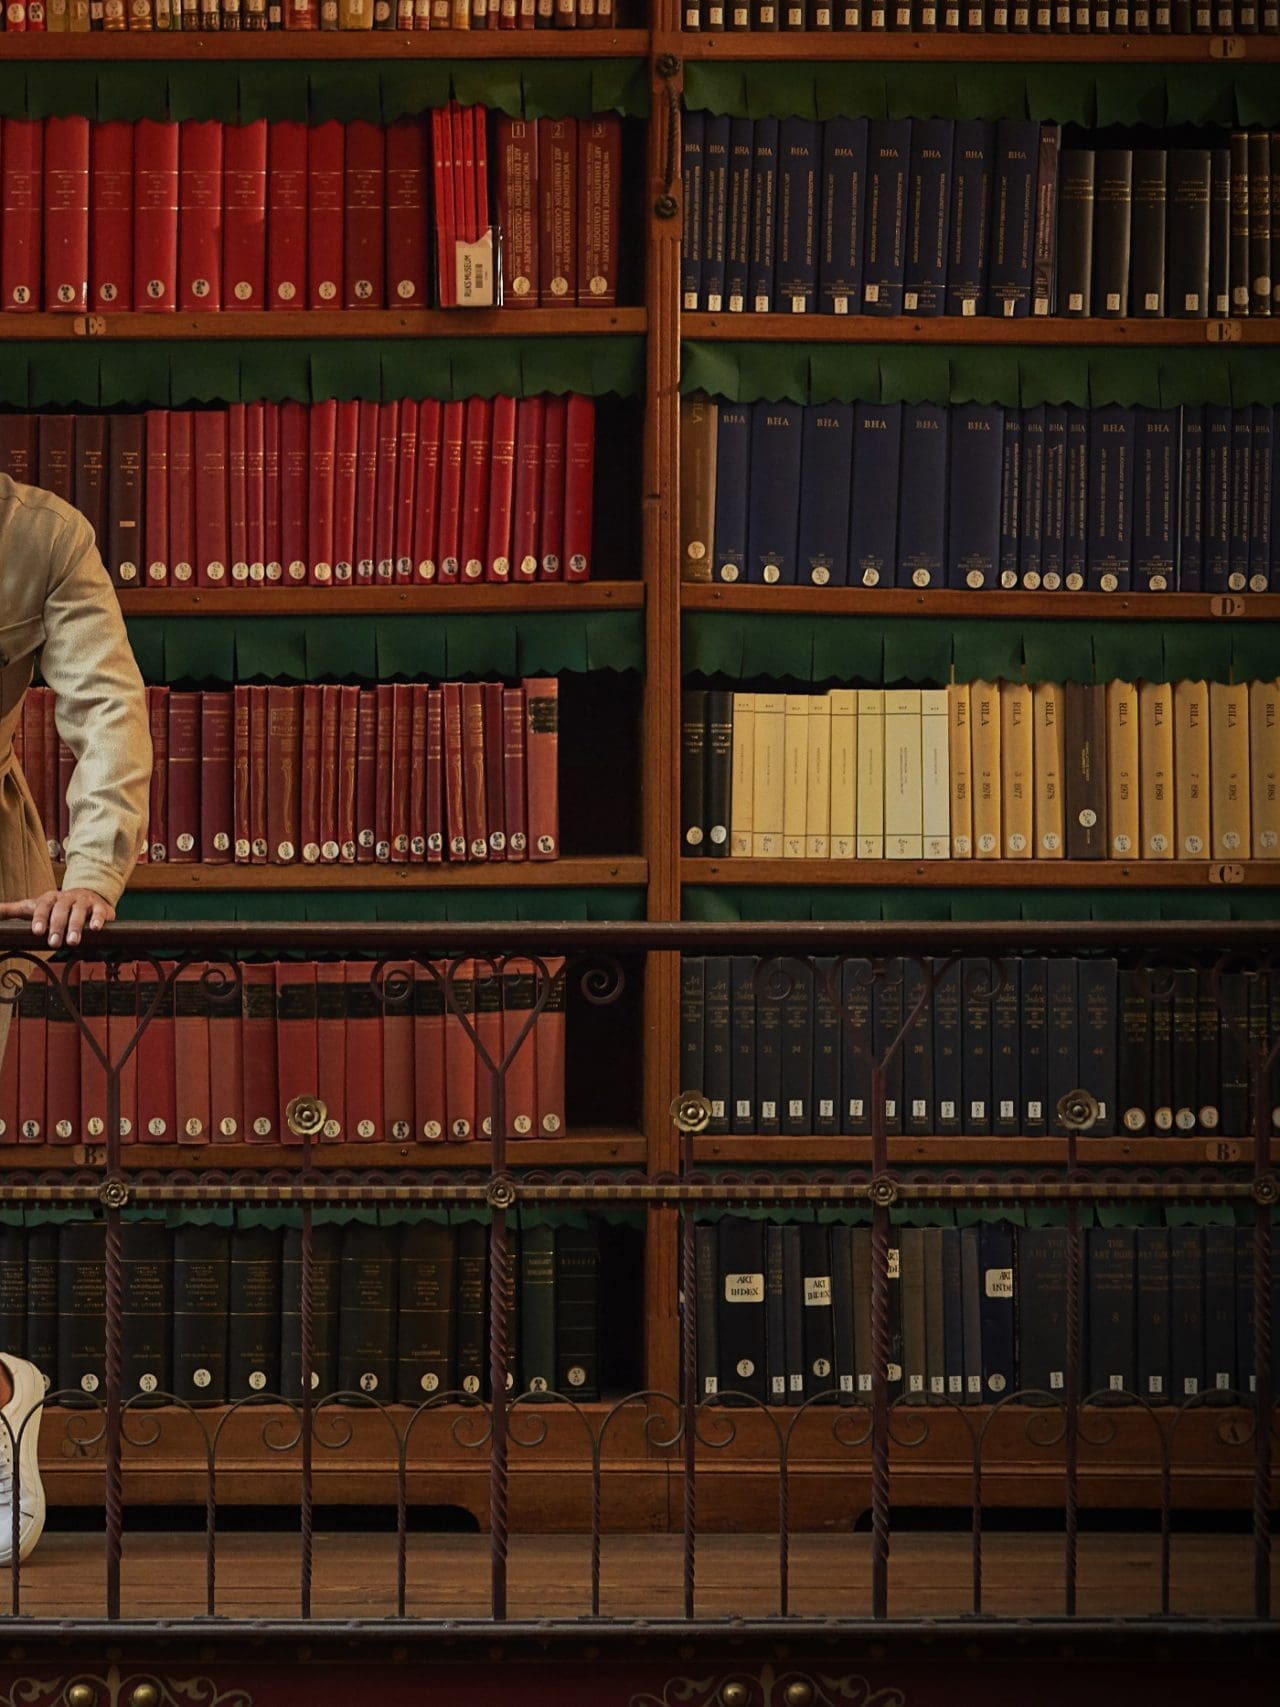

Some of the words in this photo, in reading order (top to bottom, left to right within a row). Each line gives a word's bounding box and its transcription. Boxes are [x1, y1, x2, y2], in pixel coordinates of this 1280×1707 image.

[516, 124, 521, 135] 1
[554, 124, 562, 136] 2
[595, 124, 602, 135] 3
[685, 144, 700, 153] BHA
[710, 144, 725, 154] BHA
[734, 146, 750, 154] BHA
[757, 147, 773, 156] BHA
[790, 147, 809, 156] BHA
[834, 148, 853, 157] BHA
[880, 149, 898, 158] BHA
[922, 150, 942, 158] BHA
[965, 150, 984, 159] BHA
[1008, 151, 1027, 159] BHA
[723, 415, 746, 424] BHA
[767, 417, 790, 426] BHA
[816, 418, 840, 428] BHA
[864, 420, 888, 429] BHA
[916, 420, 938, 429] BHA
[968, 422, 991, 431] BHA
[1102, 424, 1126, 432] BHA
[1146, 424, 1170, 433] BHA
[1222, 598, 1235, 615] D
[958, 702, 966, 726] RILA
[982, 701, 990, 727] RILA
[1013, 702, 1022, 727] RILA
[1046, 701, 1054, 727] RILA
[1120, 702, 1128, 727] RILA
[1154, 702, 1163, 728] RILA
[1190, 703, 1198, 728] RILA
[1228, 704, 1236, 728] RILA
[1266, 704, 1274, 728] RILA
[1219, 865, 1233, 884] C
[84, 1145, 97, 1164] B
[1216, 1142, 1230, 1160] B
[736, 1276, 754, 1284] ART
[812, 1280, 826, 1288] ART
[730, 1287, 758, 1296] INDEX
